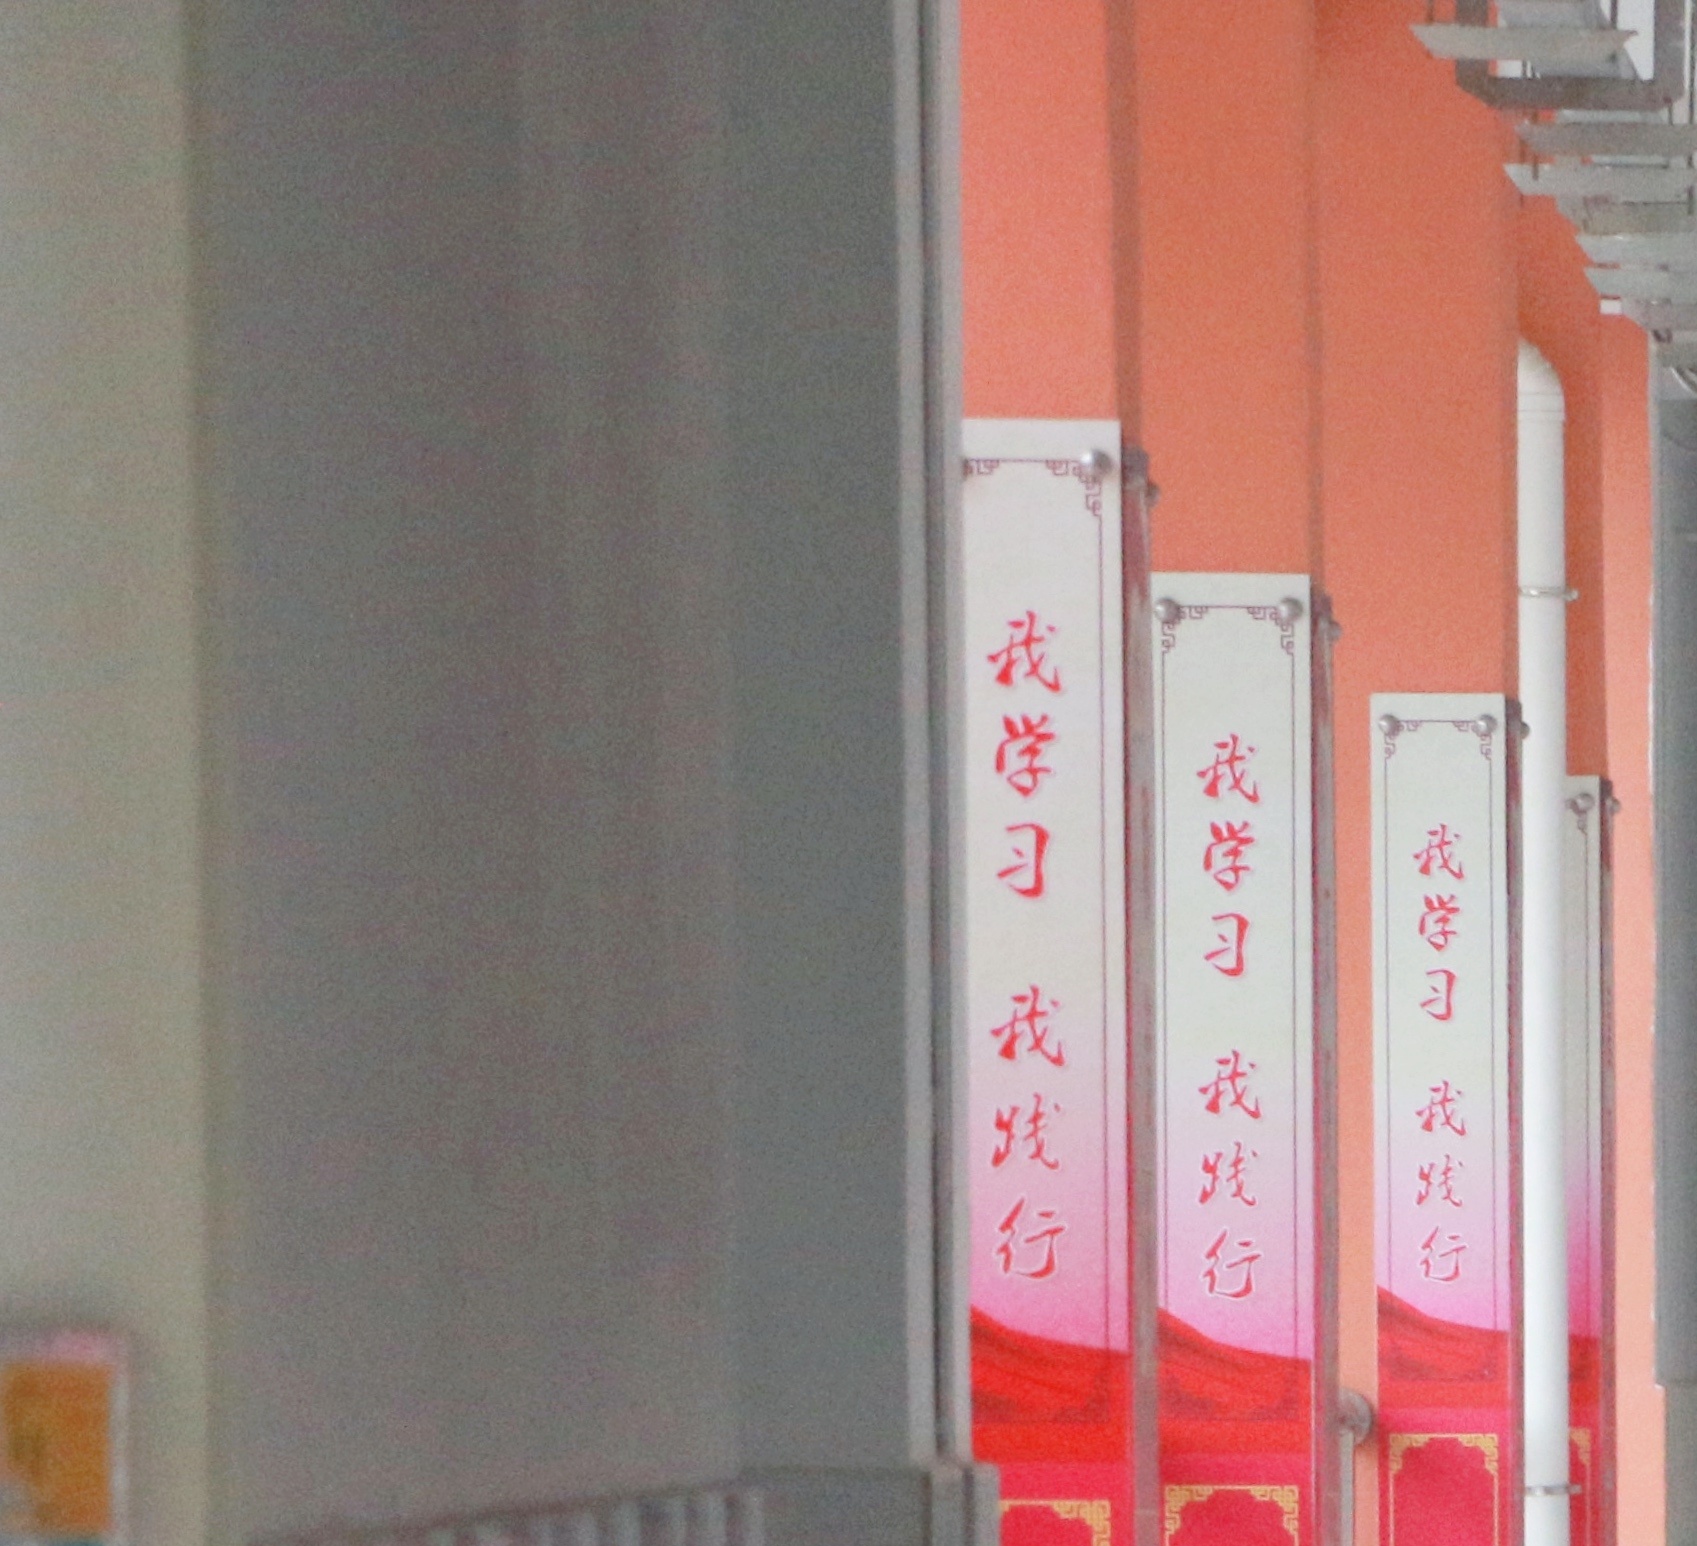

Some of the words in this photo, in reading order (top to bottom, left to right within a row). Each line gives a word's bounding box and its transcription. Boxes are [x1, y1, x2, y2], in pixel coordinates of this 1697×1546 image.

[985, 610, 1064, 900] 我学习
[1198, 732, 1262, 979] 我学习
[1414, 822, 1466, 1023] 我学习
[988, 983, 1067, 1280] 我践行
[1198, 1048, 1264, 1299] 我践行
[1416, 1078, 1469, 1283] 我践行
